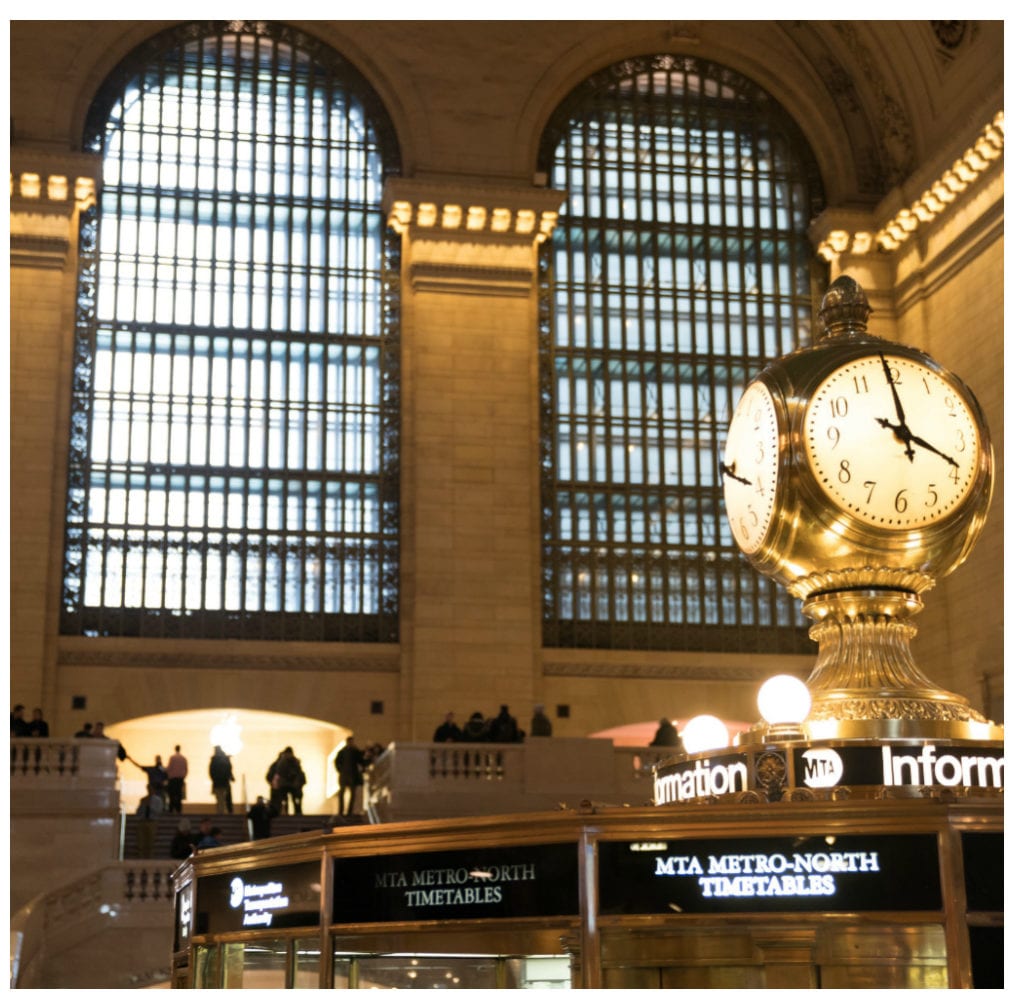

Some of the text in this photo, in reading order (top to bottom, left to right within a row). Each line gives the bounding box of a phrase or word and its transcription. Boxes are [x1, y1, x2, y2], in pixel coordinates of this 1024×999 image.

[853, 375, 868, 394] 11
[883, 366, 902, 385] 2
[922, 377, 930, 395] 1
[830, 397, 848, 417] 10
[826, 426, 840, 450] 9
[956, 430, 966, 452] 3
[838, 459, 852, 484] 8
[948, 466, 961, 485] 4
[863, 481, 876, 504] 7
[894, 489, 908, 513] 6
[925, 484, 938, 507] 5
[803, 757, 834, 779] MTA
[655, 852, 880, 875] MTA METRO-NORTH
[375, 863, 536, 888] MTA METRO-NORTH
[698, 874, 836, 897] TIMETABLES
[405, 886, 503, 907] TIMETABLES
